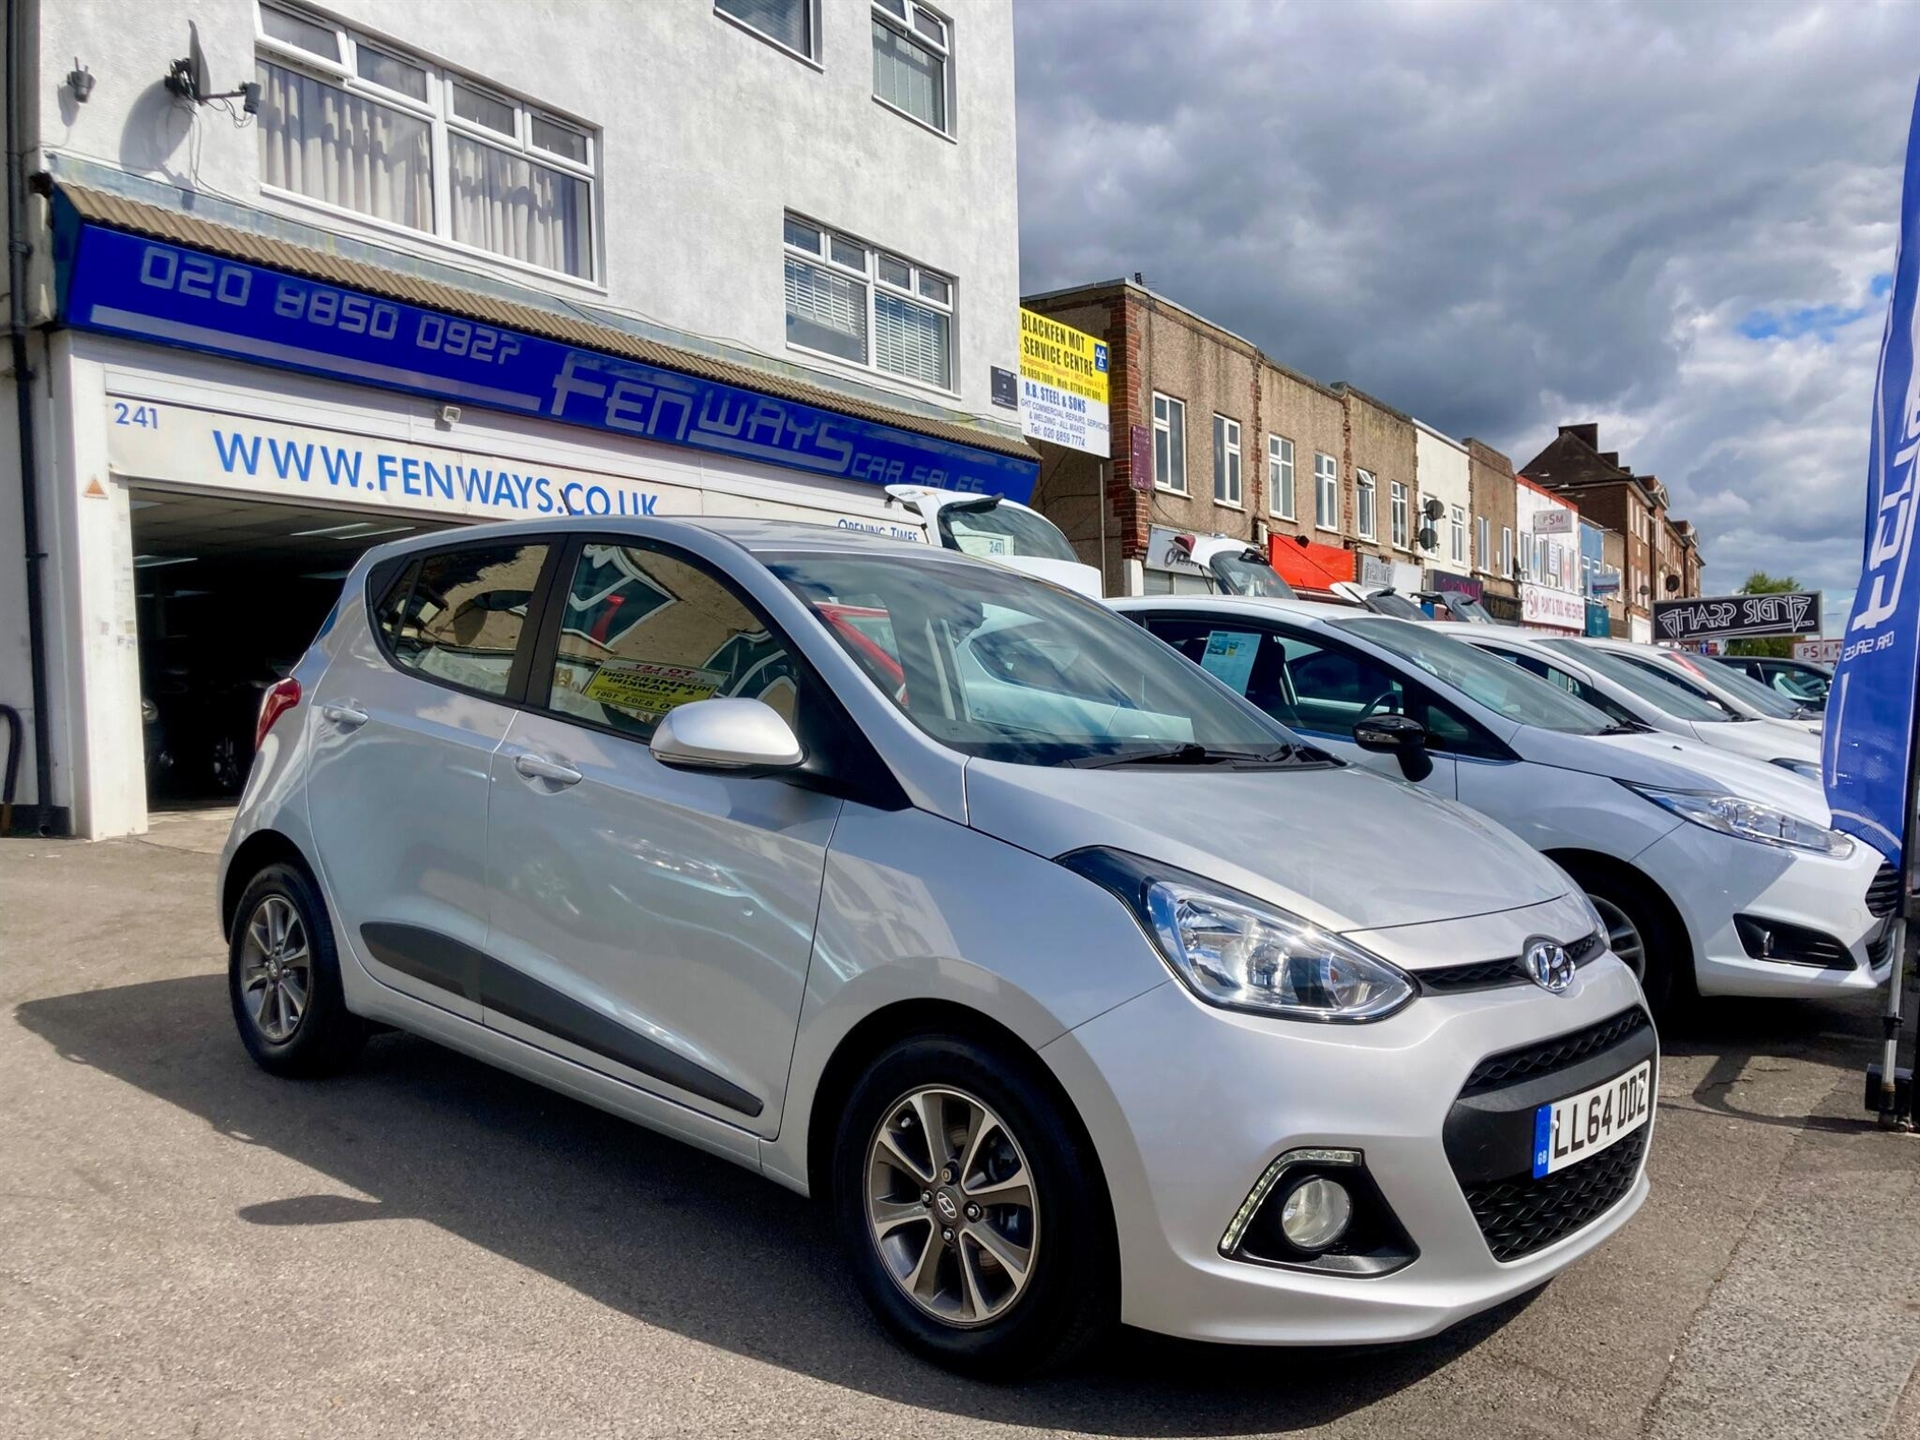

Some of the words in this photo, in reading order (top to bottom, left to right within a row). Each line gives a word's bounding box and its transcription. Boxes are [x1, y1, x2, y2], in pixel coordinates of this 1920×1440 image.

[140, 246, 253, 307] 020
[274, 278, 399, 341] 8850
[416, 314, 522, 365] 0927
[1021, 312, 1066, 346] BLACKFEN
[1068, 331, 1085, 353] MOT
[1024, 336, 1061, 366] SERVICE
[1063, 351, 1093, 377] CENTRE
[1025, 382, 1039, 399] R.B.
[1040, 387, 1060, 406] STEEL
[1061, 396, 1067, 408] &
[1068, 396, 1086, 413] SONS
[1032, 402, 1065, 418] COMMERCIAL
[114, 403, 158, 429] 241
[1033, 413, 1056, 426] WELDING
[1069, 424, 1086, 434] MAKES
[1030, 422, 1042, 435] Tel:
[1043, 427, 1055, 439] 020
[1072, 435, 1086, 446] 7774
[851, 453, 905, 483] CAR
[1543, 513, 1564, 525] PSM
[1658, 602, 1737, 638] SHARP
[1744, 595, 1812, 633] SIGNS
[1554, 1089, 1613, 1159] LL64
[1617, 1068, 1648, 1129] DDZ
[1537, 1150, 1547, 1165] GB
